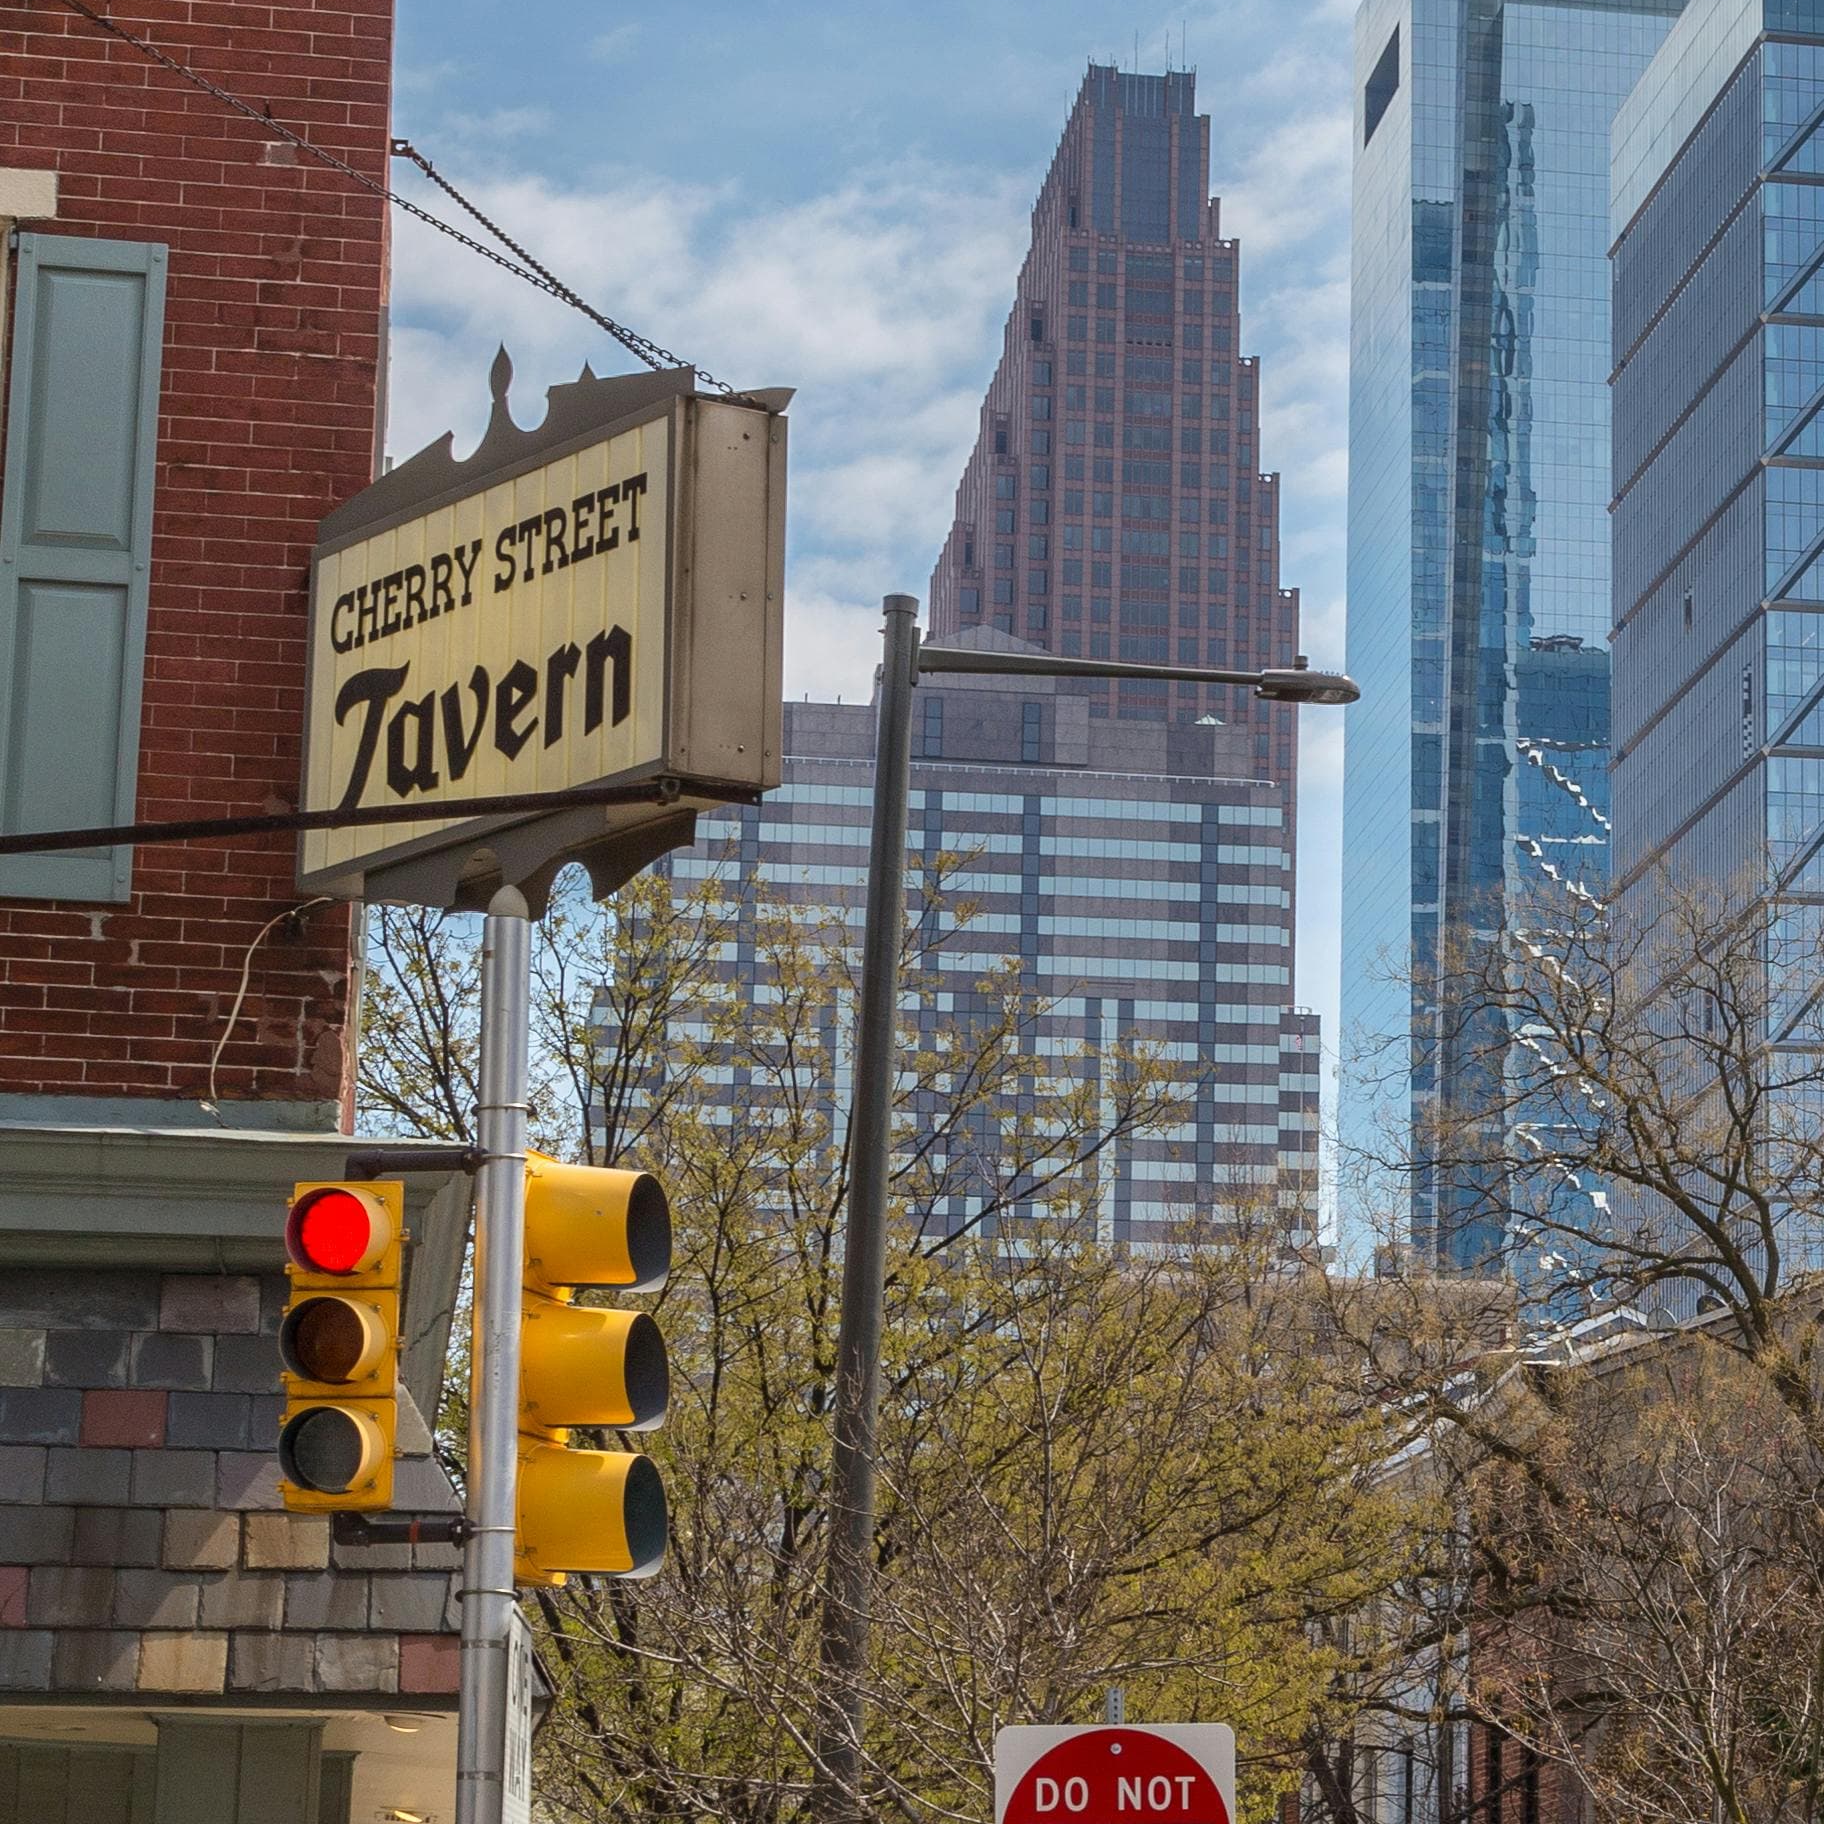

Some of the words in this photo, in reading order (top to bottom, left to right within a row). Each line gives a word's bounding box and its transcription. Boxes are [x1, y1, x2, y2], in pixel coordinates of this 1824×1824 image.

[330, 538, 482, 656] CHERRY
[493, 472, 648, 594] STREET
[334, 622, 633, 811] Tavern
[1035, 1777, 1090, 1812] DO
[1117, 1775, 1196, 1811] NOT
